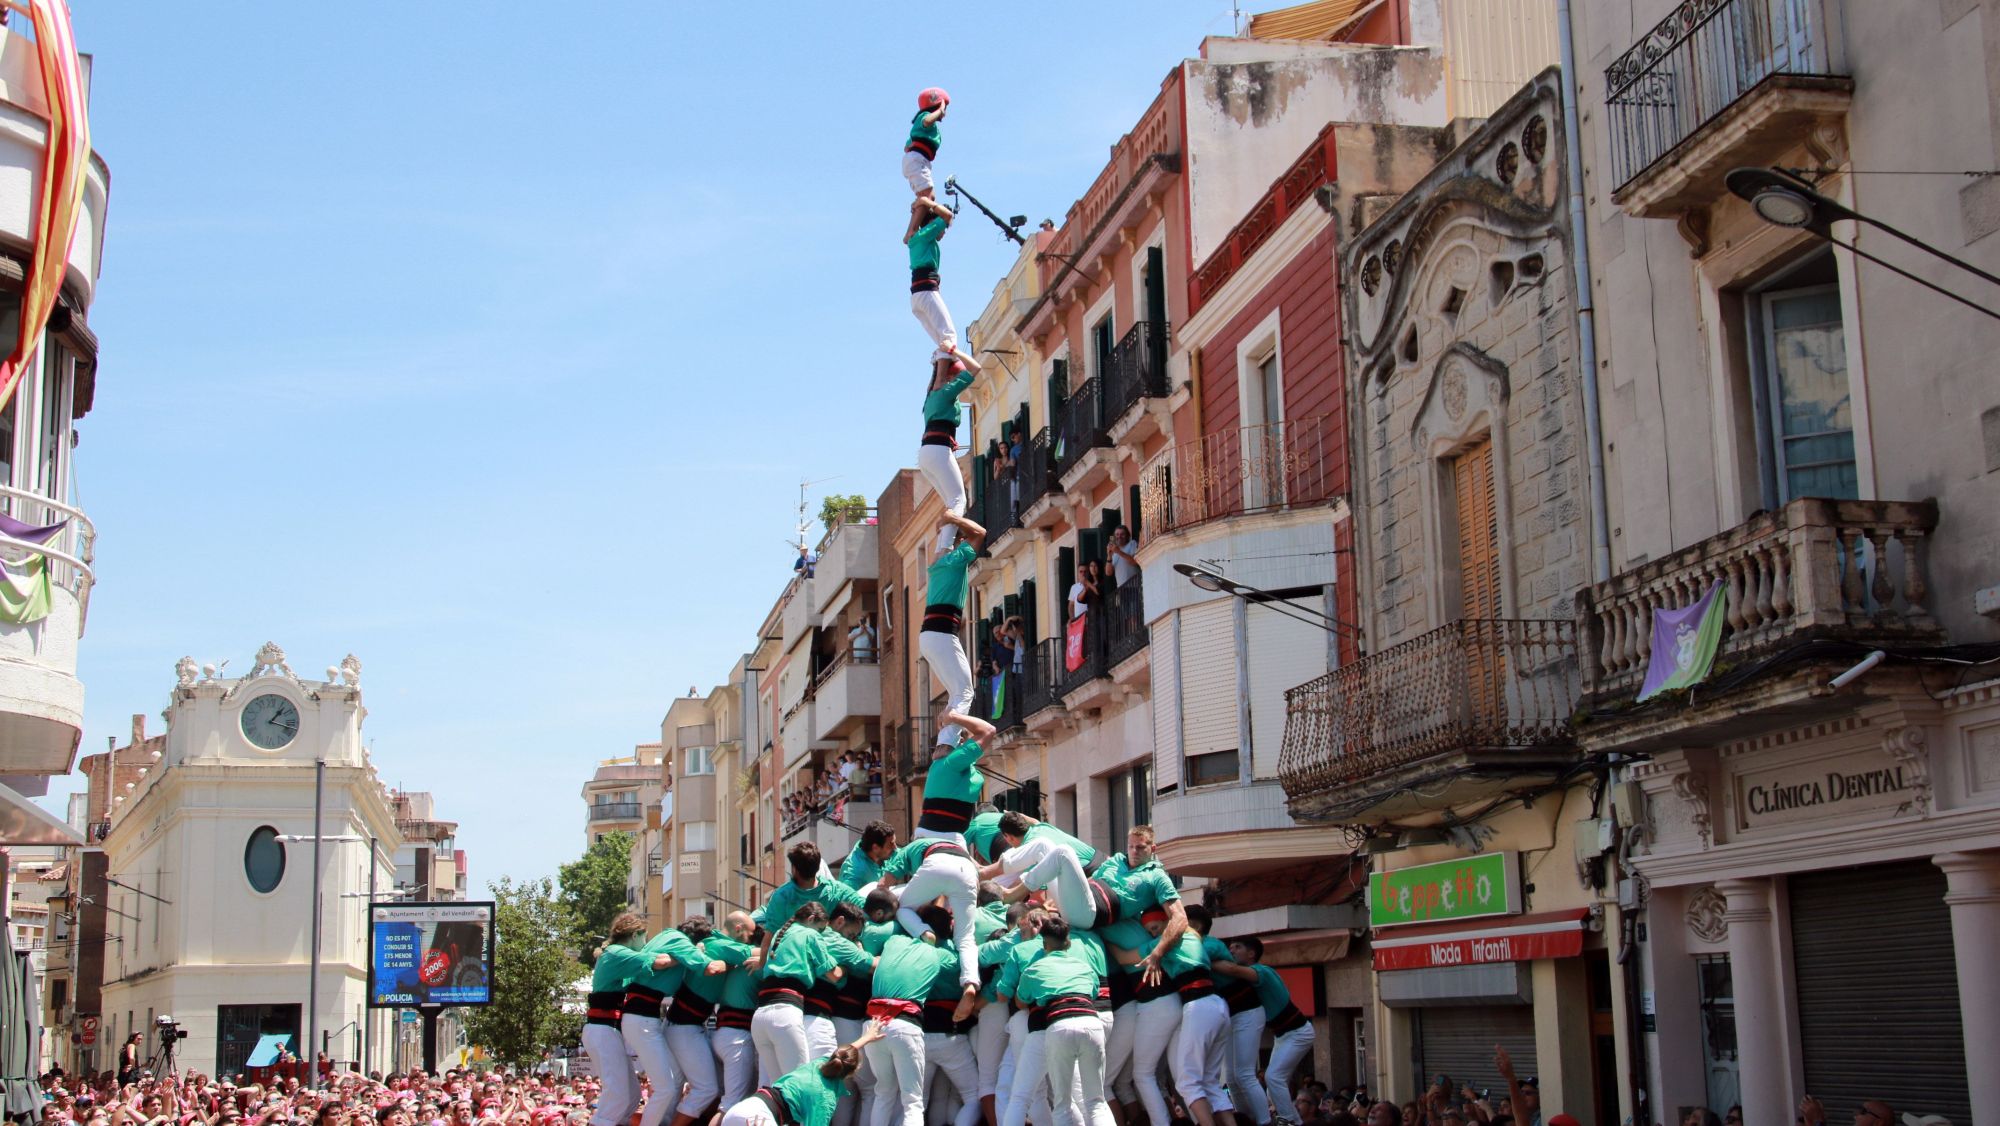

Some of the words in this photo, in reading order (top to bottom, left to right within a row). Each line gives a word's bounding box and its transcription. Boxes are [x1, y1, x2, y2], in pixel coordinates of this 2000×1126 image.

[1748, 781, 1824, 815] CLÍNICA
[1826, 766, 1909, 803] DENTAL
[1380, 866, 1492, 922] Geppetto
[424, 959, 444, 977] 200€
[1430, 942, 1462, 966] Moda
[1471, 938, 1511, 963] Infantil
